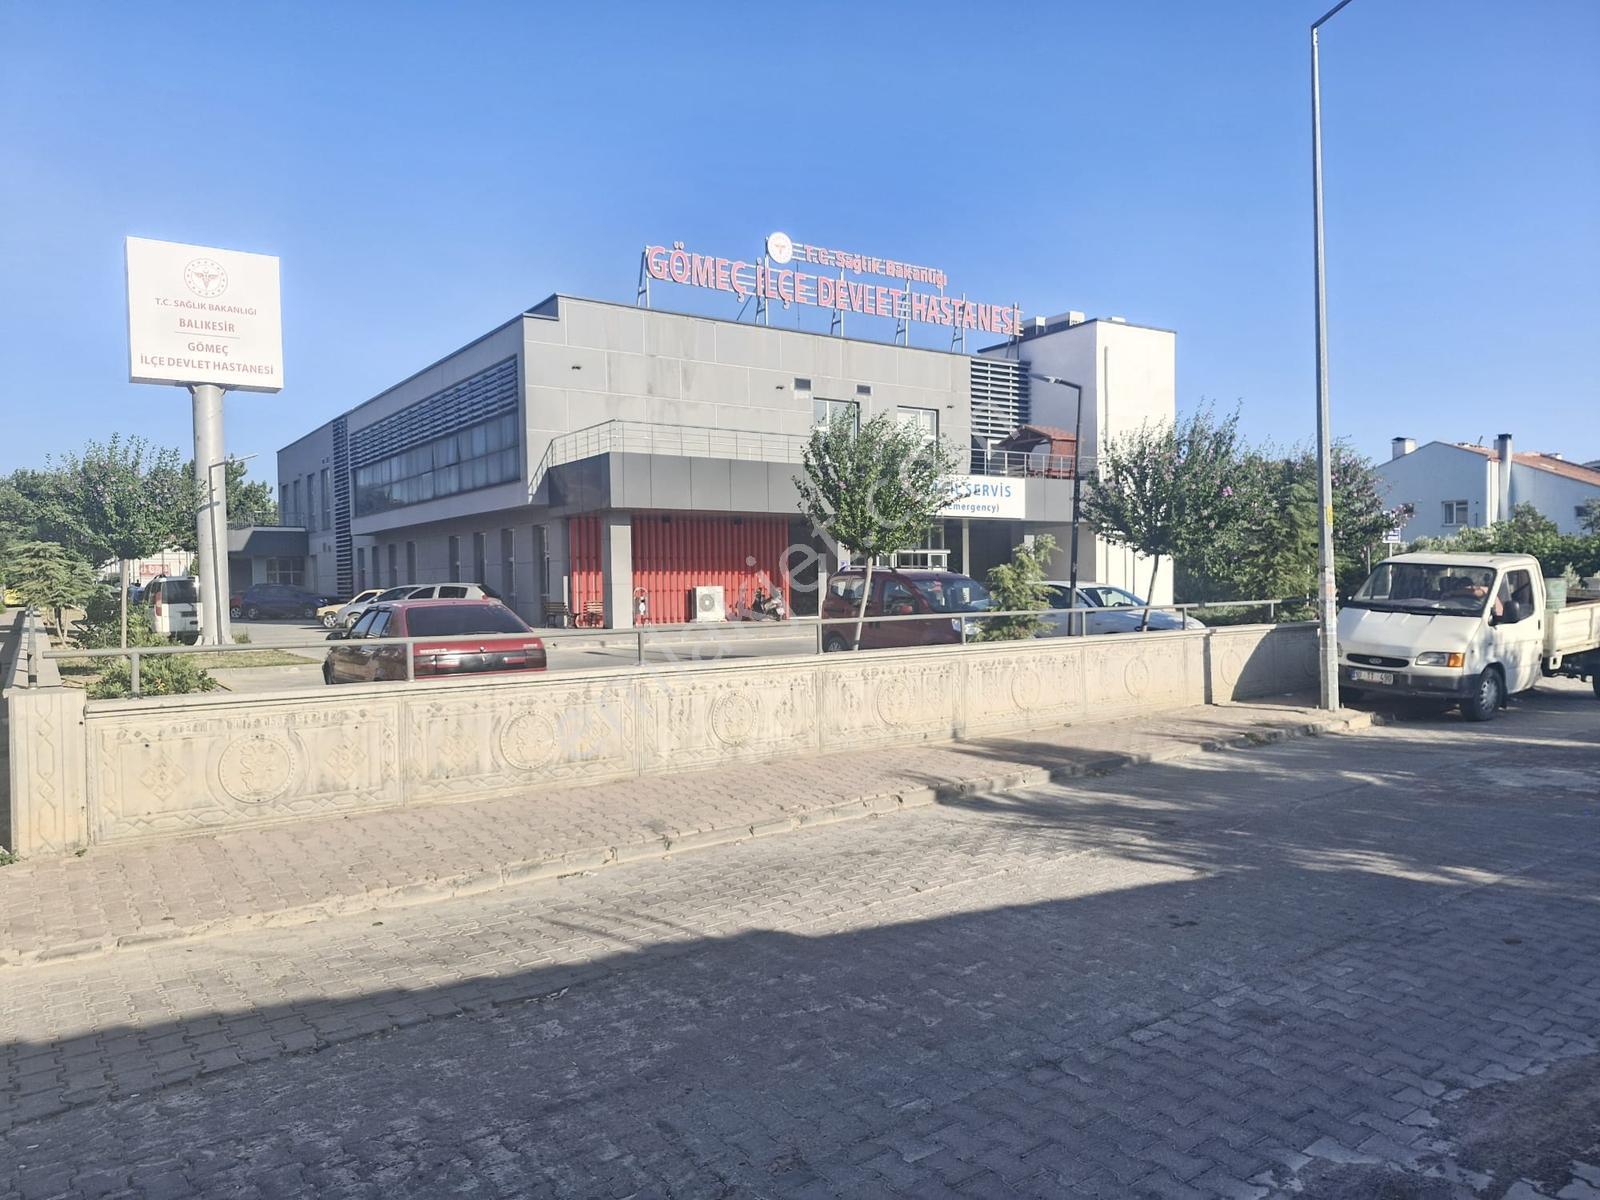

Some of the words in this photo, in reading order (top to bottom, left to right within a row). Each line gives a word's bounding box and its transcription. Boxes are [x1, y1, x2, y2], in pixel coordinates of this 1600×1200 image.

[803, 244, 834, 267] T.C.
[647, 241, 747, 303] GÖMEÇ
[756, 257, 808, 310] İLÇE
[816, 276, 902, 318] DEVLET
[911, 292, 1022, 337] HASTANESİ
[155, 297, 172, 307] T.C.
[174, 299, 206, 311] SAĞLIK
[208, 303, 257, 316] BAKANLIĞI
[179, 318, 235, 333] BALIKESİR
[187, 341, 230, 357] GÖMEÇ
[140, 353, 165, 369] İLÇE
[167, 356, 211, 370] DEVLET
[213, 361, 274, 375] HASTANESİ
[966, 482, 1012, 498] SERVİS
